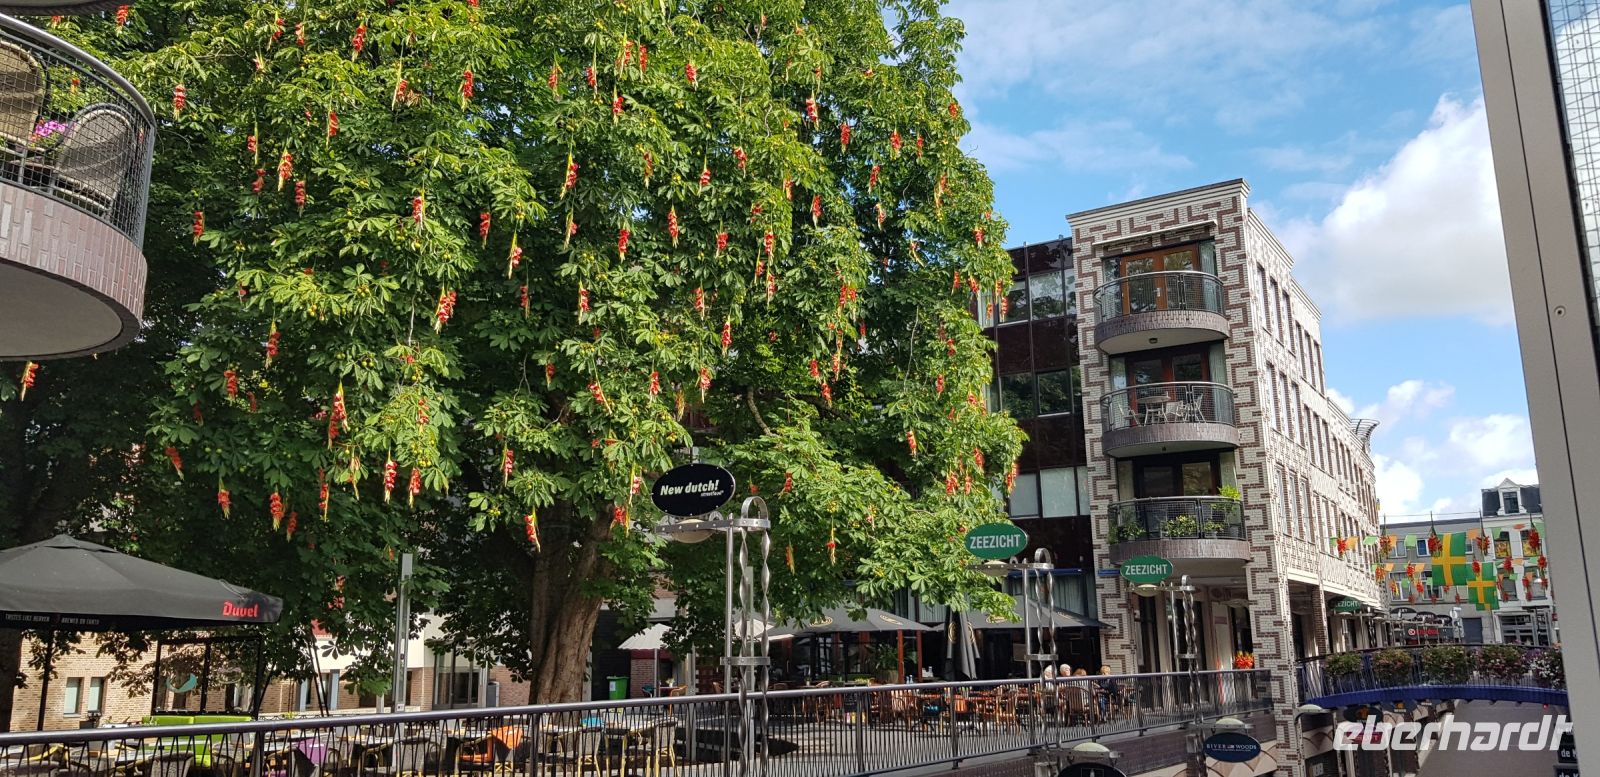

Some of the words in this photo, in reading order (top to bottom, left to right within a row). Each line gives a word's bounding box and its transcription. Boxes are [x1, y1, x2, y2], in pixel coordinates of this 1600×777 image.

[660, 485, 683, 496] New
[684, 480, 719, 493] dutch!
[970, 534, 1020, 548] ZEEZICHT
[1125, 564, 1168, 575] ZEEZICHT
[223, 601, 259, 618] Duvel
